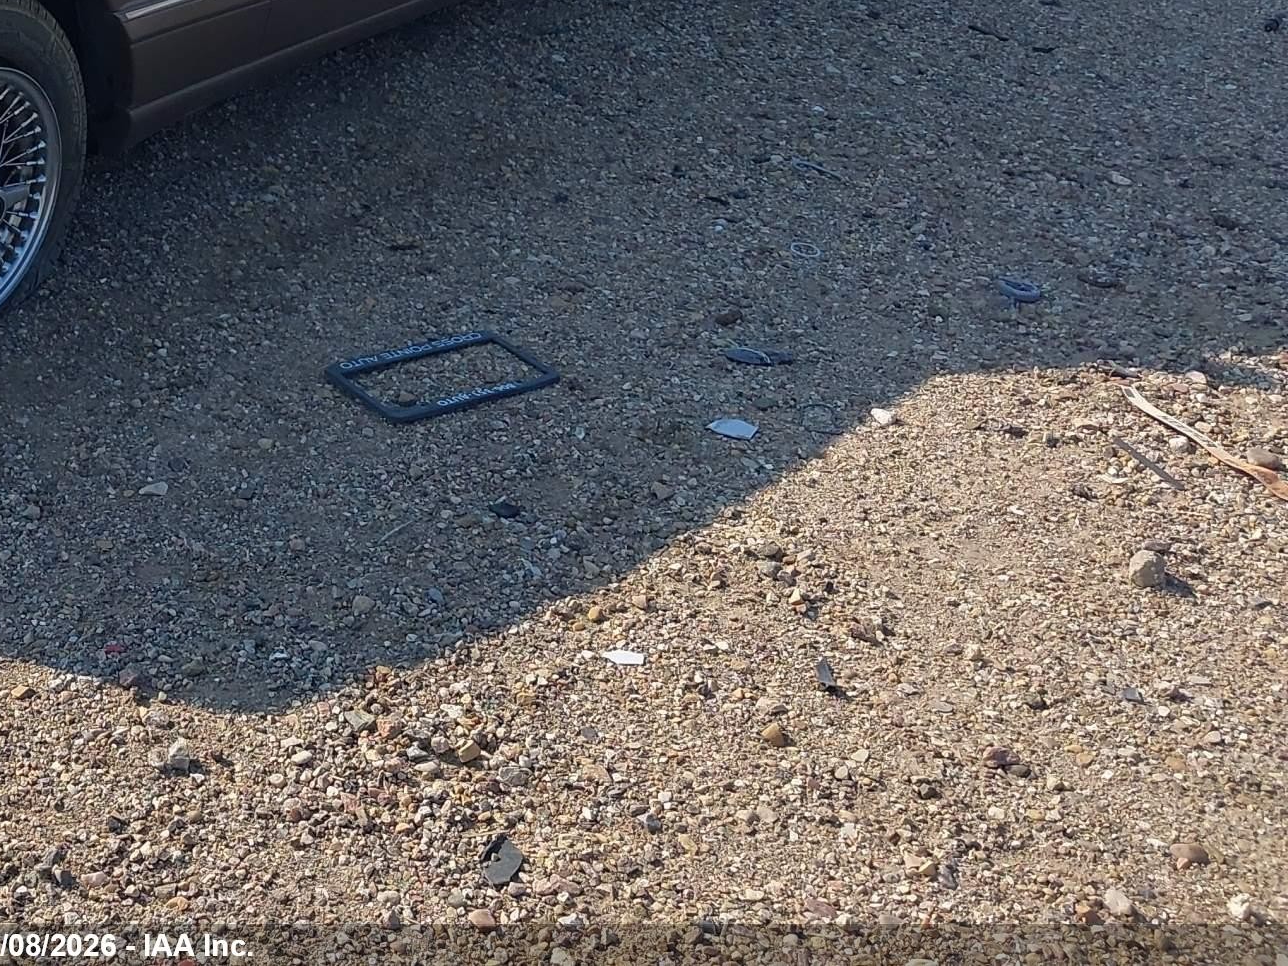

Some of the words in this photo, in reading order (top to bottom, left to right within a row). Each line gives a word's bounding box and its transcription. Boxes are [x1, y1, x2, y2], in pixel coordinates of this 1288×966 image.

[431, 332, 482, 348] CROSS
[379, 343, 433, 360] POINTE
[339, 355, 378, 369] AUTO
